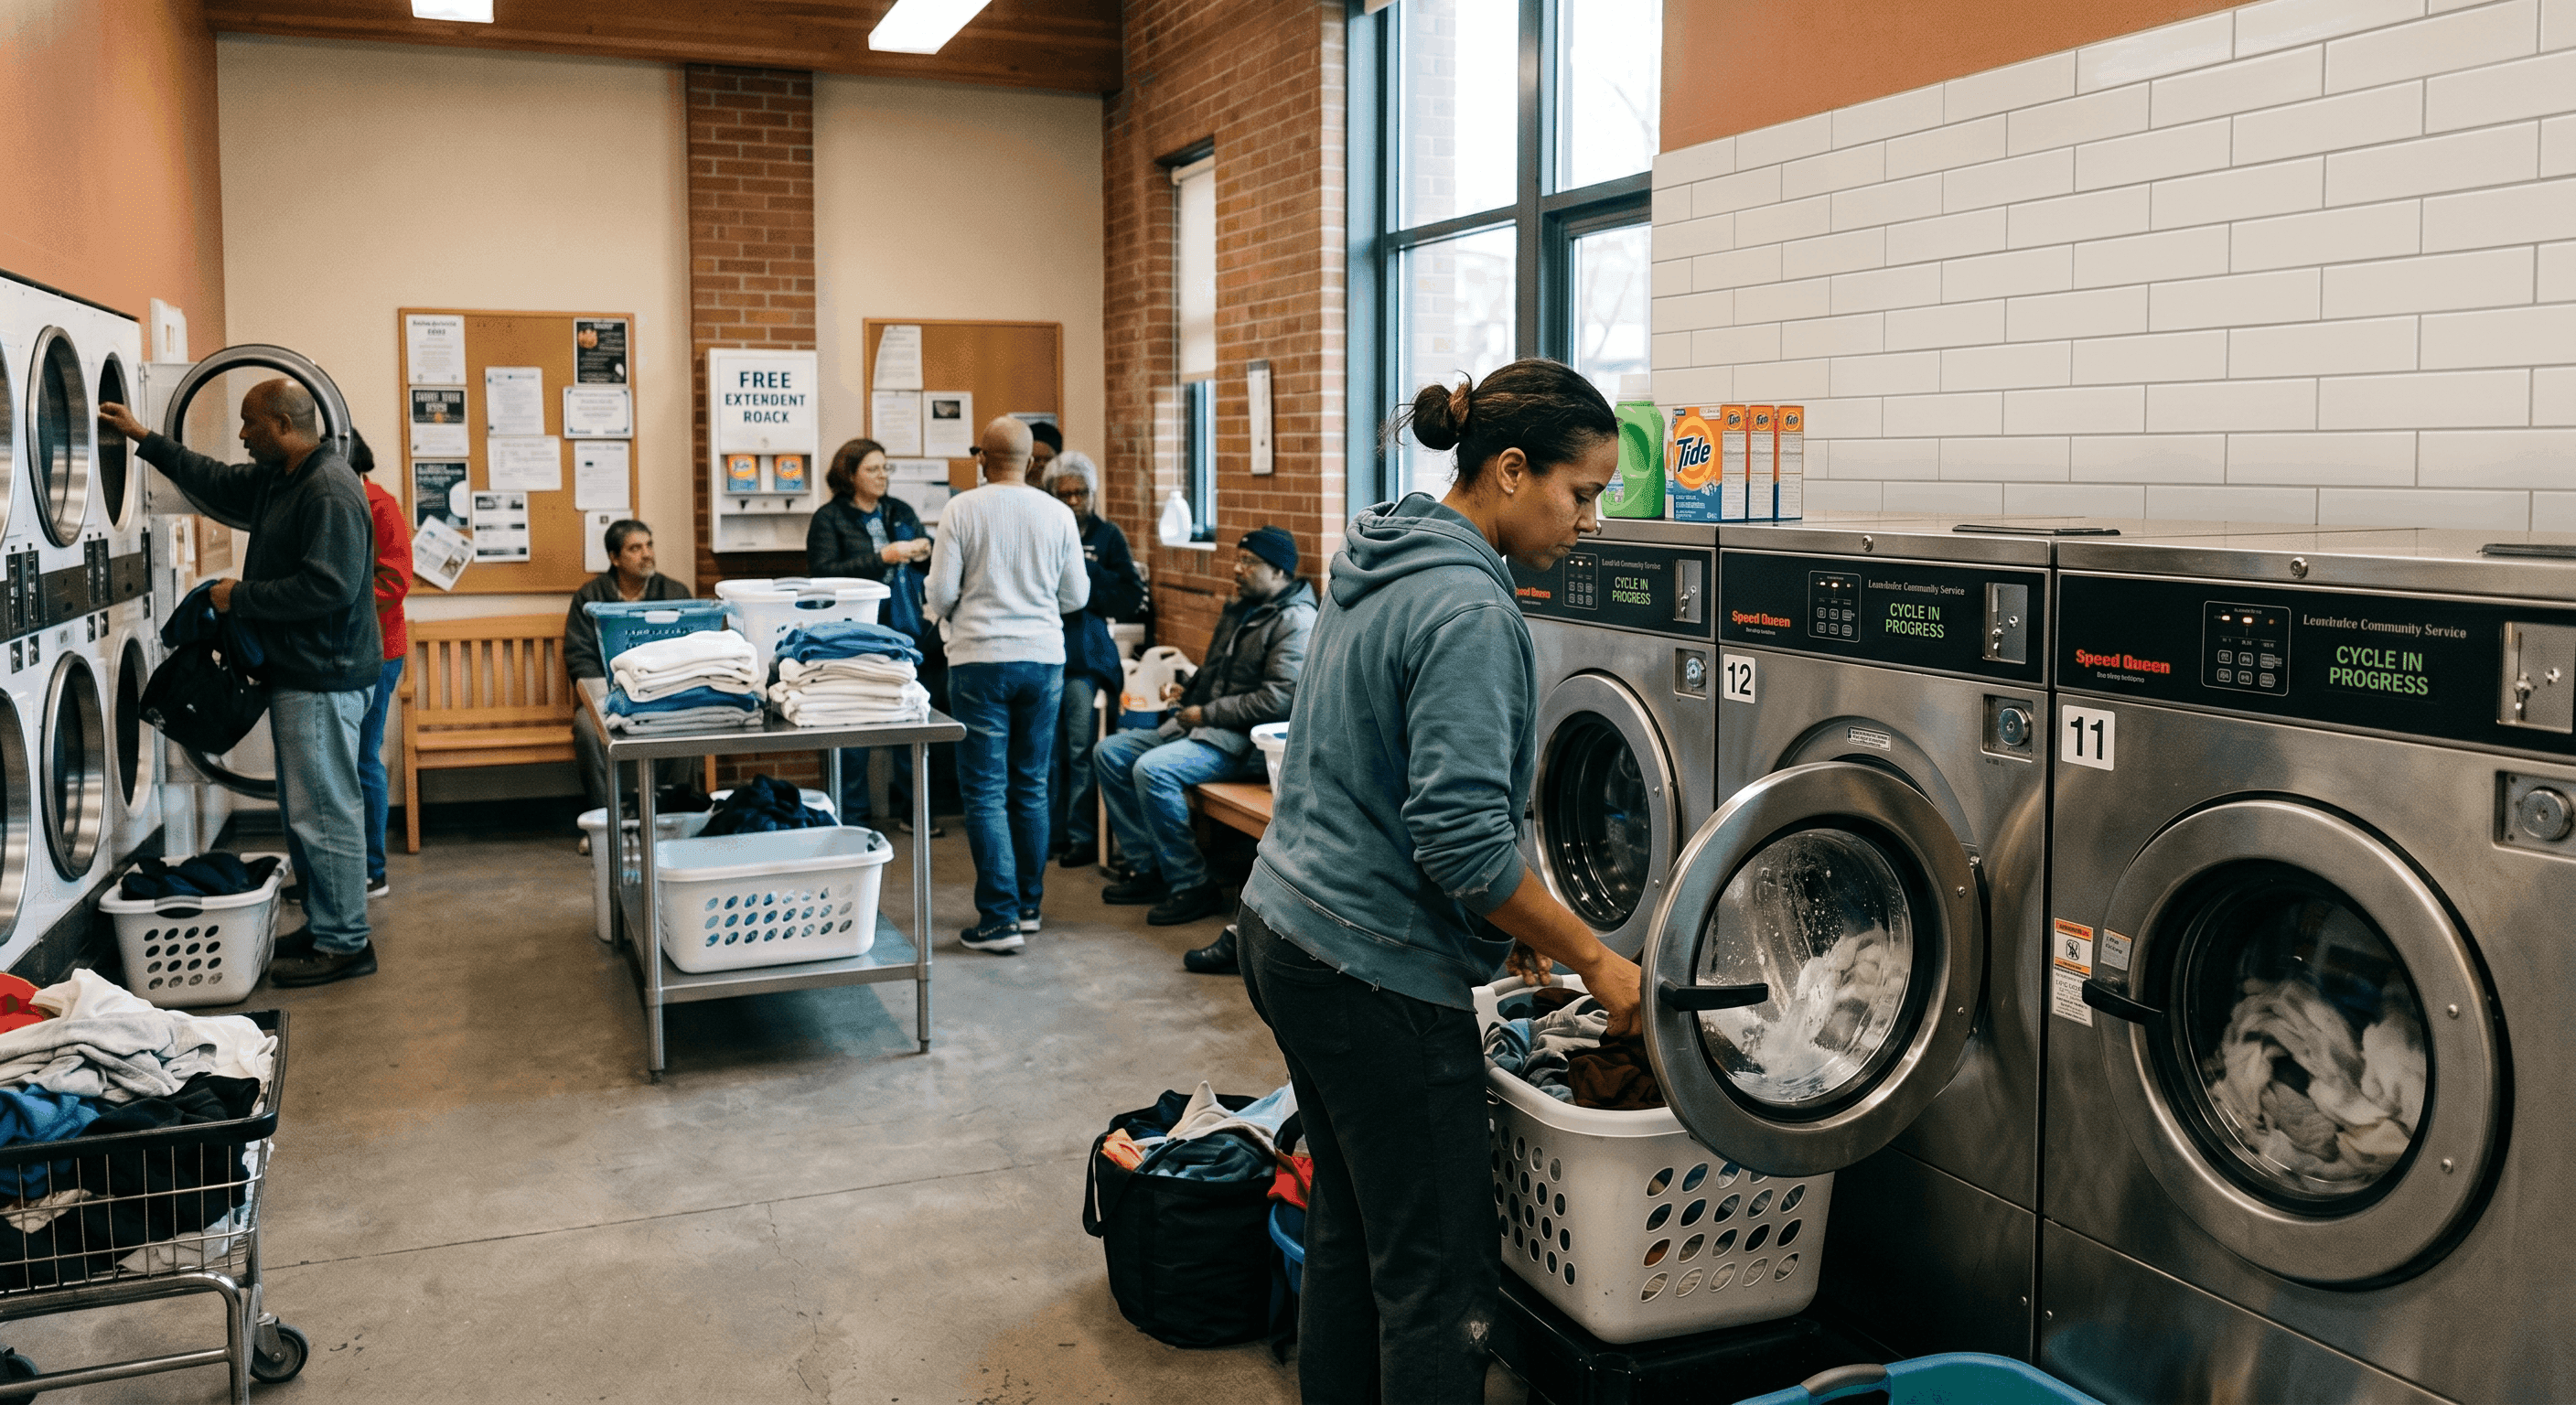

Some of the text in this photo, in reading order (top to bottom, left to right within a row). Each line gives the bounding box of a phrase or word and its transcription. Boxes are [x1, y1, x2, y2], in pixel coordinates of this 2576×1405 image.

[739, 371, 791, 389] FREE
[743, 411, 789, 424] ROACK
[1676, 435, 1712, 473] Tide
[1615, 576, 1648, 591] CYCLE IN
[1612, 590, 1651, 605] PROGRESS
[1732, 610, 1791, 627] Speed Queen
[1890, 603, 1940, 621] CYCLE IN
[1885, 618, 1945, 638] PROGRESS
[2360, 618, 2422, 638] Community
[2424, 623, 2467, 638] Service
[2076, 649, 2171, 674] Speed Queen
[2336, 645, 2423, 672] CYCLE IN
[1727, 661, 1752, 696] 12
[2329, 667, 2429, 695] PROGRESS
[2070, 715, 2104, 761] 11
